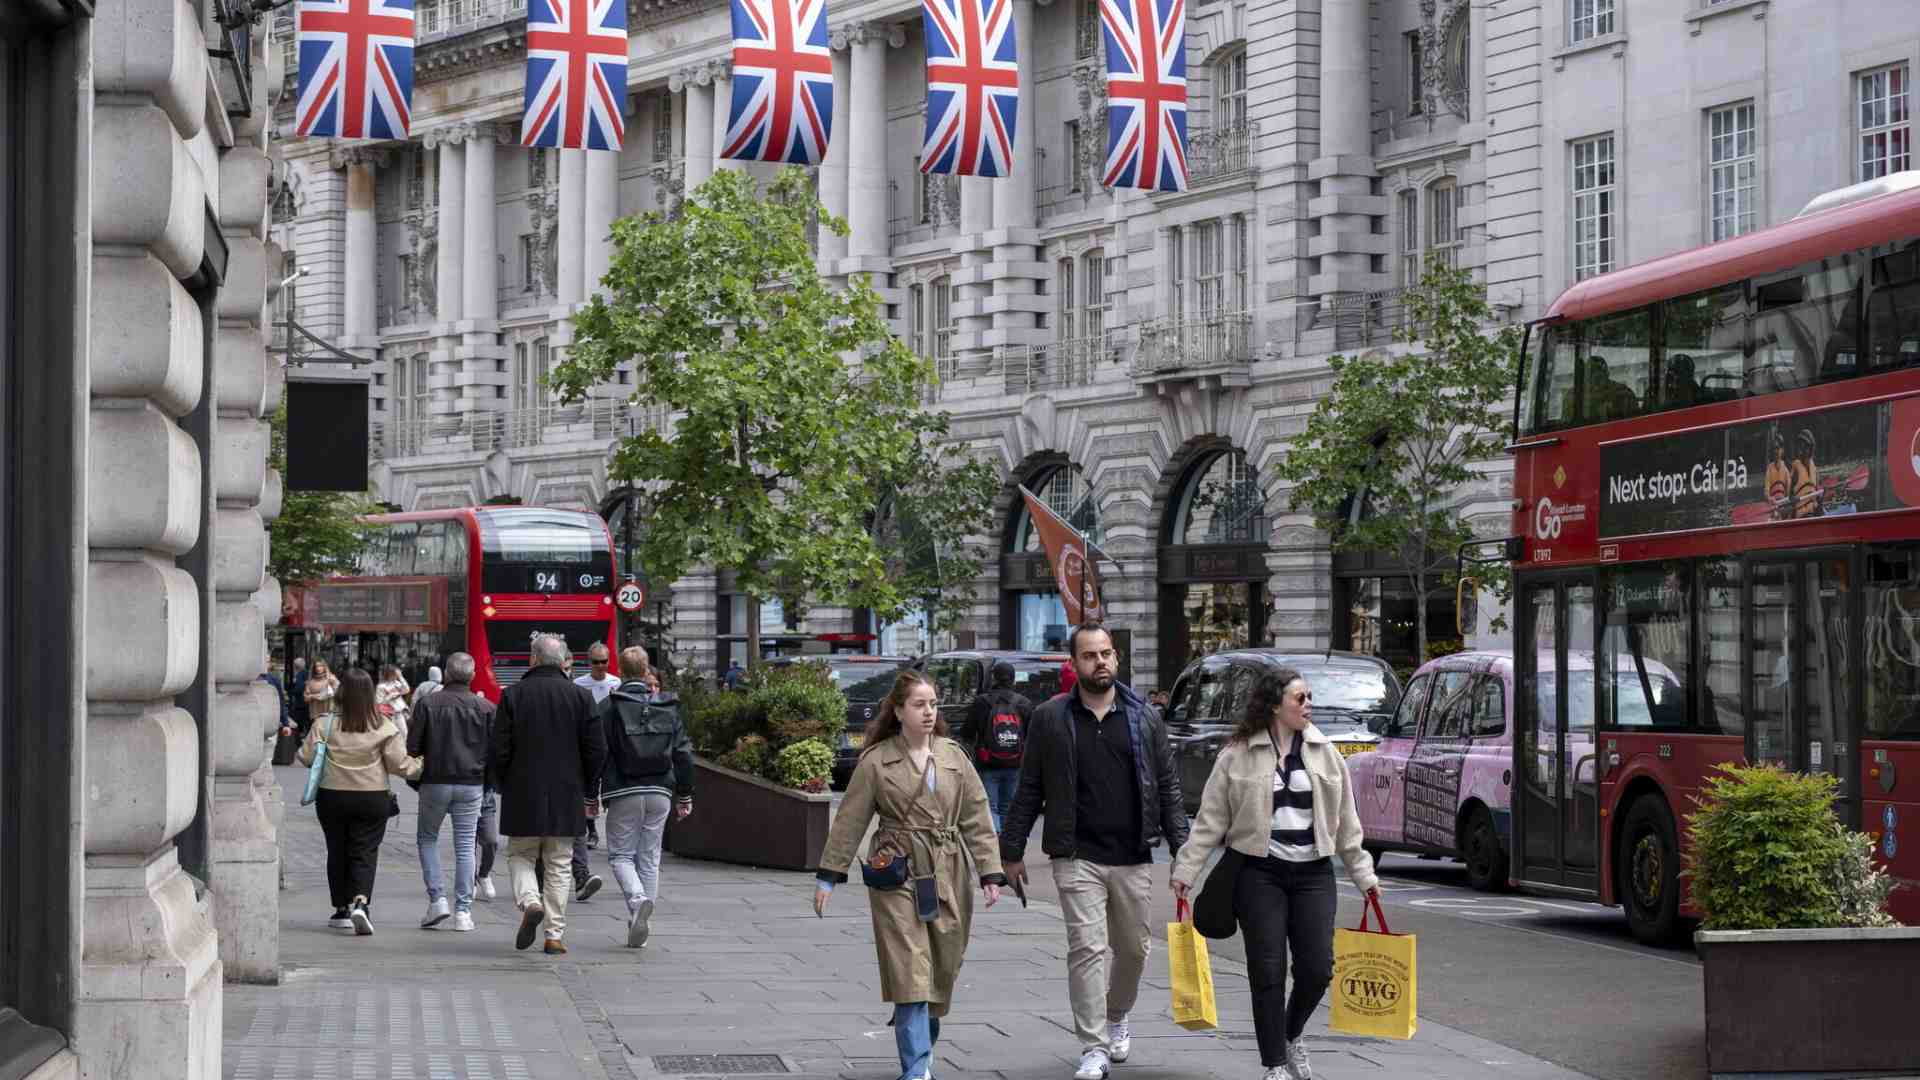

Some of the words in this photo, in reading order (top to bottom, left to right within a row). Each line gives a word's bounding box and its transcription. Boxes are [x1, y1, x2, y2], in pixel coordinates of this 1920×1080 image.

[1609, 474, 1646, 504] Next
[1648, 471, 1687, 504] stop:
[1690, 460, 1719, 494] Cát
[1723, 456, 1747, 490] Bà
[1536, 497, 1561, 540] Go
[536, 572, 558, 590] 94
[621, 591, 641, 603] 20
[1375, 775, 1391, 788] LDN
[1345, 978, 1398, 1001] TWG
[1360, 997, 1382, 1008] TEA
